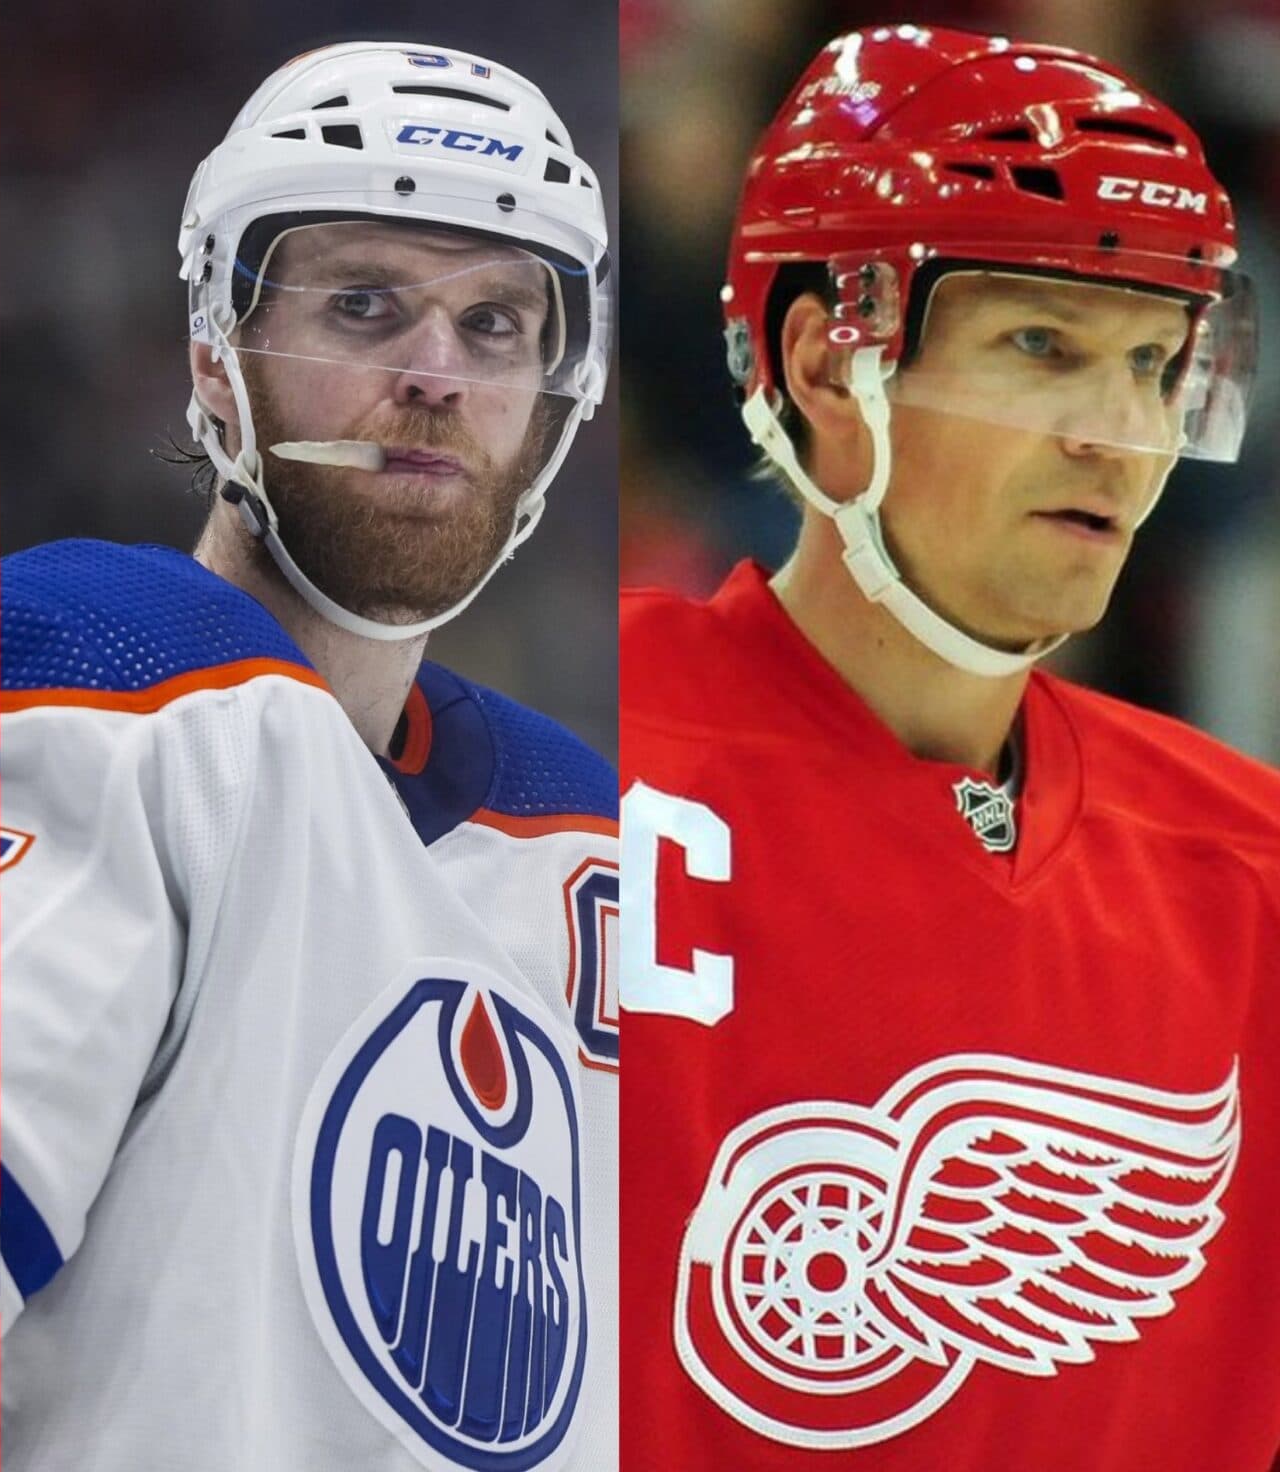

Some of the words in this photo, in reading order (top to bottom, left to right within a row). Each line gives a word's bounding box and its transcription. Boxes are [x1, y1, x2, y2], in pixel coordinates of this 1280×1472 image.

[396, 124, 524, 163] CCM
[1096, 175, 1208, 214] CCM
[620, 779, 734, 1027] C
[360, 1112, 569, 1444] OILERS
